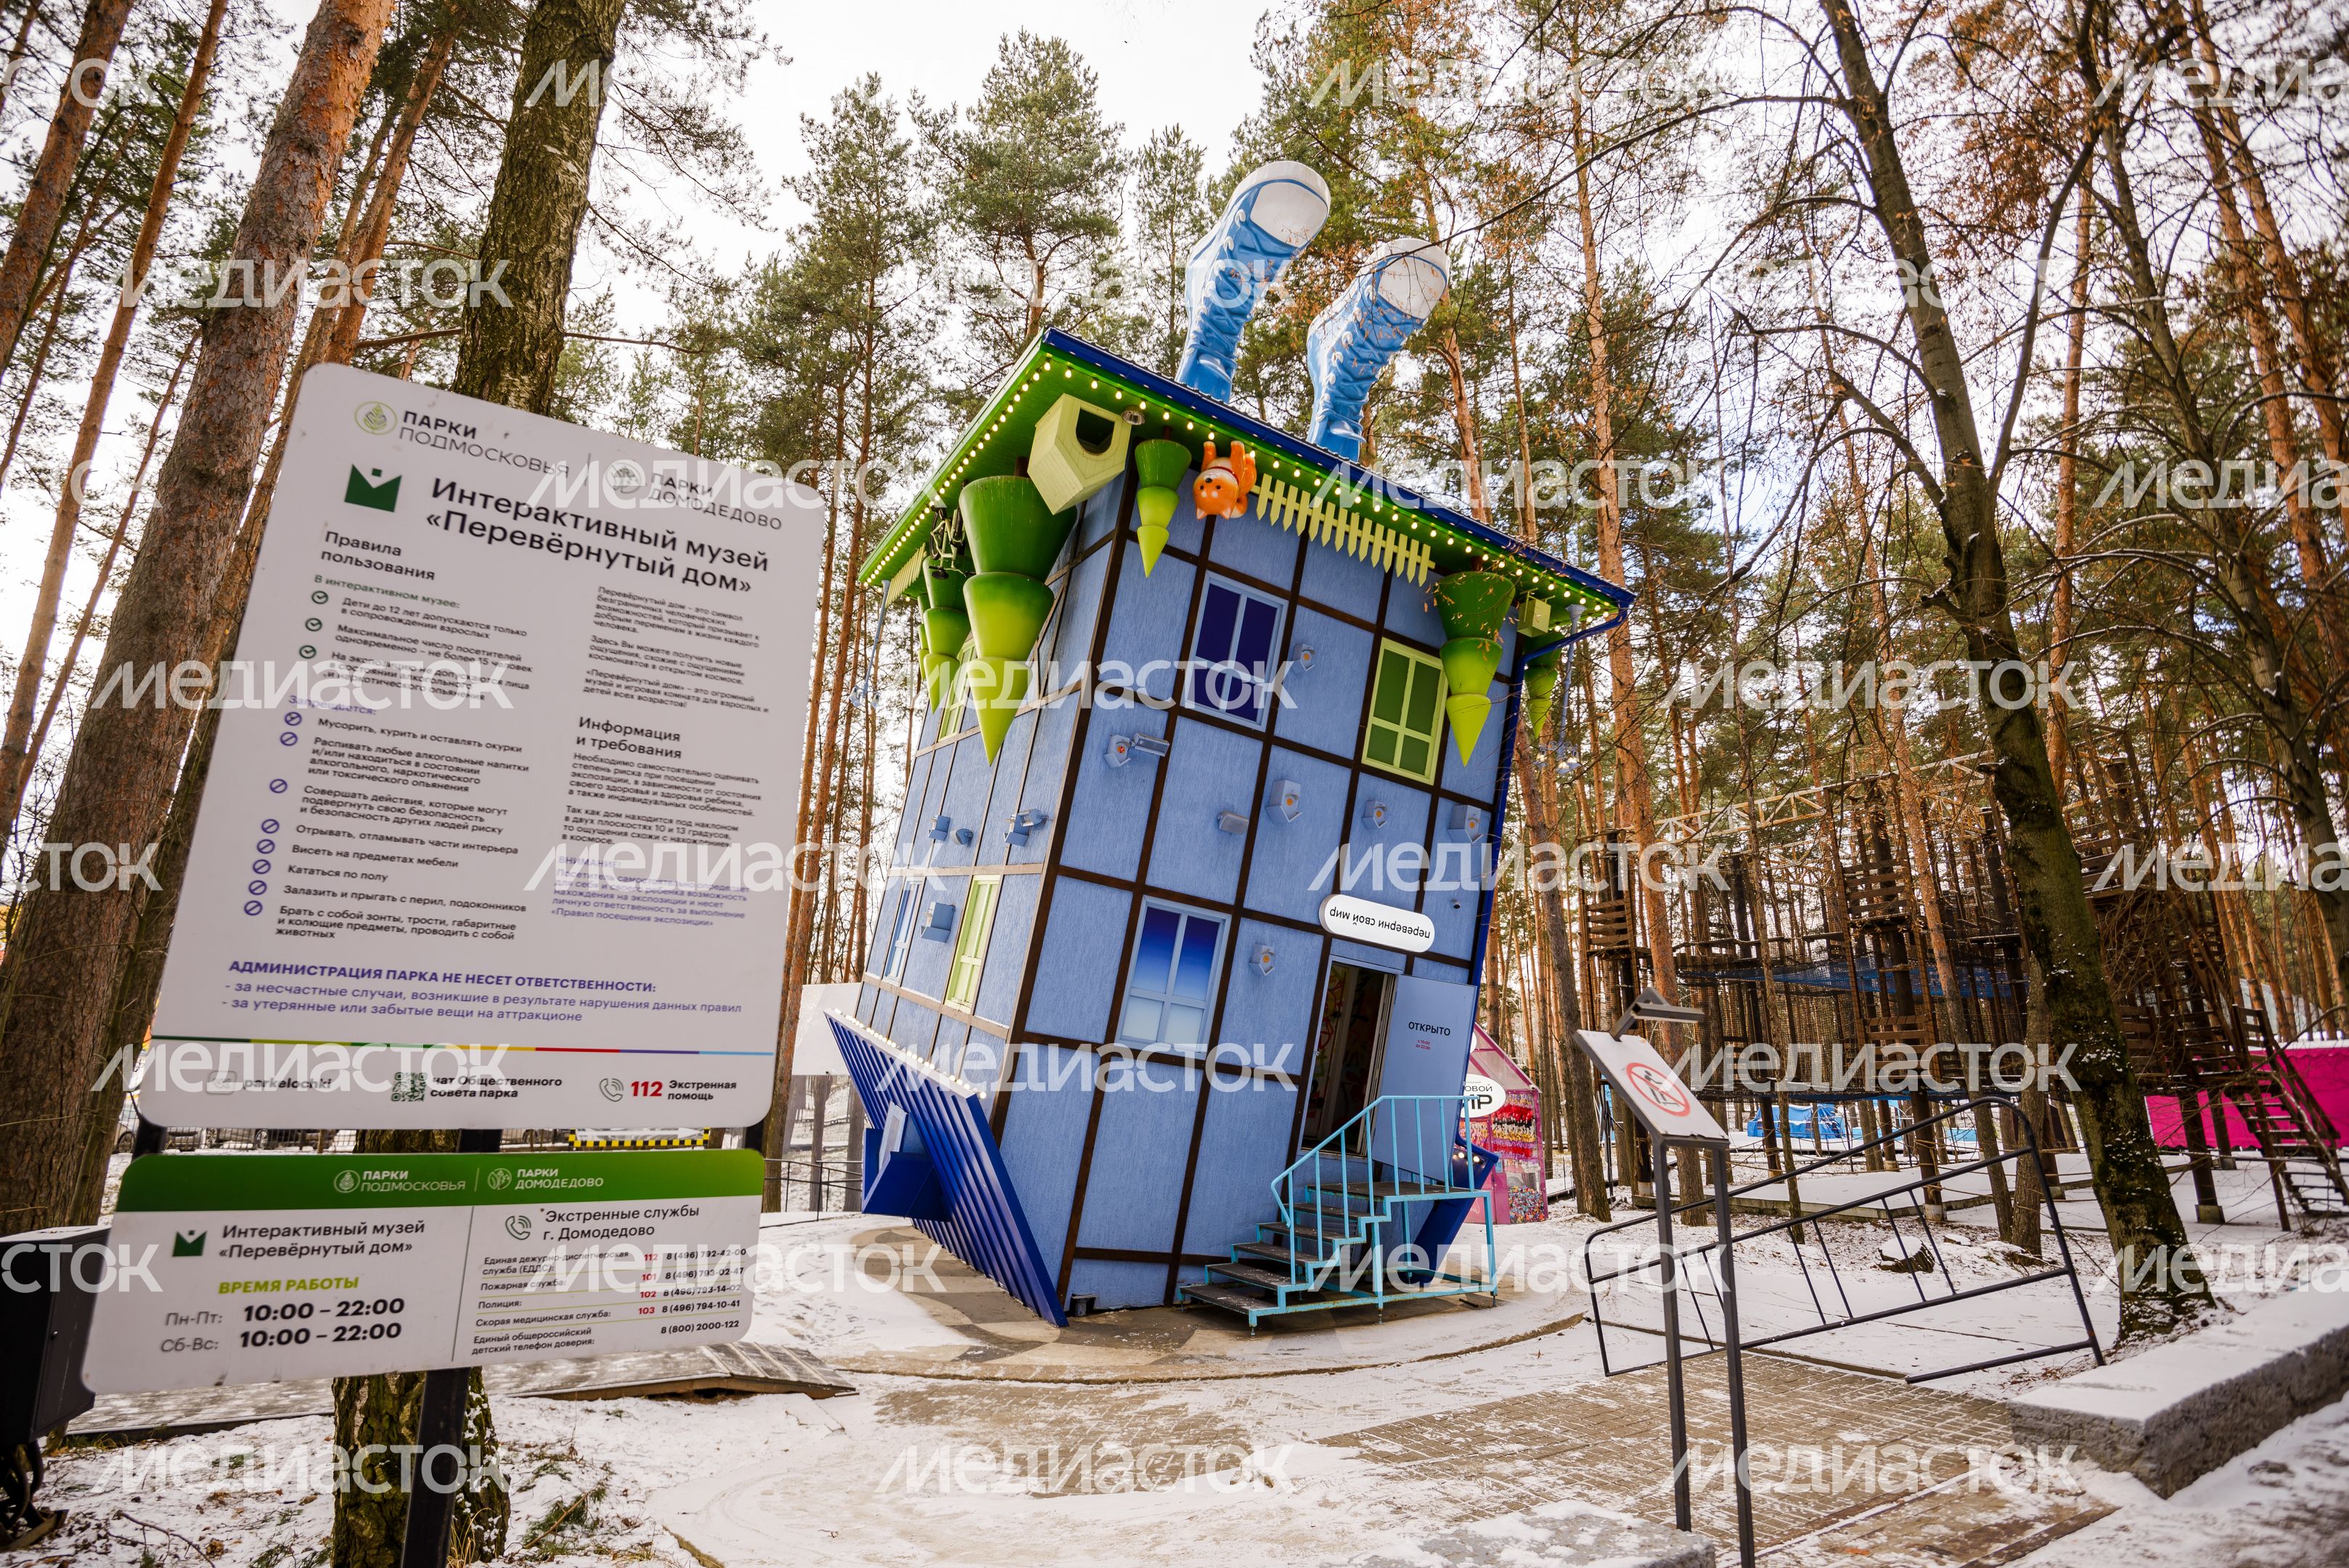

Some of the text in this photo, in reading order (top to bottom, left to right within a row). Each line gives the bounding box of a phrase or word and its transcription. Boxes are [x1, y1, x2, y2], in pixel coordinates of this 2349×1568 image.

[403, 411, 476, 439] ПАРКИ
[399, 426, 569, 481] ПОДМОСКОВЬЯ
[651, 473, 713, 497] ПАРКИ
[647, 486, 782, 530] ДОМОДЕДОВО
[432, 478, 768, 571] Интерактивный музей
[325, 531, 401, 556] Правила
[427, 510, 751, 592] «Перевёрнутый дом»
[321, 551, 435, 580] пользования
[314, 574, 459, 608] В интерактивном музее:
[318, 718, 376, 734] Мусорить,
[380, 729, 417, 738] курить
[430, 735, 483, 748] оставлять
[485, 743, 522, 753] окурки
[579, 716, 680, 742] Информация
[576, 737, 682, 759] и требования
[296, 825, 356, 838] Отрывать,
[359, 833, 425, 845] отламывать
[462, 844, 518, 854] интерьера
[287, 865, 340, 877] Кататься
[360, 873, 388, 882] полу
[284, 885, 338, 897] Залазить
[351, 892, 397, 902] прыгать
[409, 897, 446, 906] перил,
[449, 900, 526, 912] подоконников
[1329, 907, 1431, 939] переверни свой мир
[229, 961, 655, 992] АДМИНИСТРАЦИЯ ПАРКА НЕ НЕСЕТ ОТВЕТСТВЕННОСТИ:
[234, 983, 252, 992] за
[256, 985, 348, 997] несчастные
[351, 989, 407, 1000] случаи,
[411, 992, 489, 1003] возникшие
[503, 996, 576, 1006] результате
[579, 1000, 650, 1009] нарушения
[700, 1004, 741, 1013] правил
[232, 1000, 248, 1008] за
[253, 1001, 336, 1012] утерянные
[371, 1003, 433, 1016] забытые
[437, 1008, 474, 1018] вещи
[497, 1010, 582, 1021] аттракционе
[1408, 1021, 1450, 1036] ОТКРЫТО
[458, 1076, 563, 1087] Общественного
[632, 1081, 663, 1097] 112
[669, 1079, 737, 1090] Экстренная
[479, 1090, 518, 1099] парка
[363, 1171, 409, 1180] ПАРКИ
[517, 1168, 558, 1177] ПАРКИ
[360, 1180, 466, 1192] ПОДМОСКОВЬЯ
[515, 1177, 604, 1190] ДОМОДЕДОВО
[545, 1204, 699, 1224] Экстренные службы
[222, 1220, 425, 1240] Интерактивный музей
[543, 1226, 655, 1241] г. Домодедово
[219, 1241, 412, 1260] «Перевёрнутый дом»
[674, 1251, 698, 1260] (496)
[484, 1256, 517, 1265] Единая
[482, 1265, 517, 1276] служба
[673, 1270, 698, 1280] (496)
[219, 1277, 359, 1294] ВРЕМЯ РАБОТЫ
[481, 1278, 563, 1291] Пожарная служба:
[671, 1288, 695, 1297] (496)
[166, 1311, 222, 1325] Пн-Пт:
[244, 1302, 314, 1322] 10:00
[335, 1298, 404, 1317] 22:00
[669, 1303, 695, 1313] (496)
[697, 1299, 740, 1310] 794-10-41
[512, 1314, 574, 1324] медицинская
[576, 1310, 611, 1320] служба:
[473, 1327, 592, 1344] Единый общероссийский
[669, 1323, 695, 1334] (800)
[696, 1320, 739, 1331] 2000-122
[161, 1338, 218, 1352] Сб-Вс:
[240, 1328, 311, 1347] 10:00
[332, 1323, 401, 1342] 22:00
[471, 1339, 595, 1355] детский телефон доверия:
